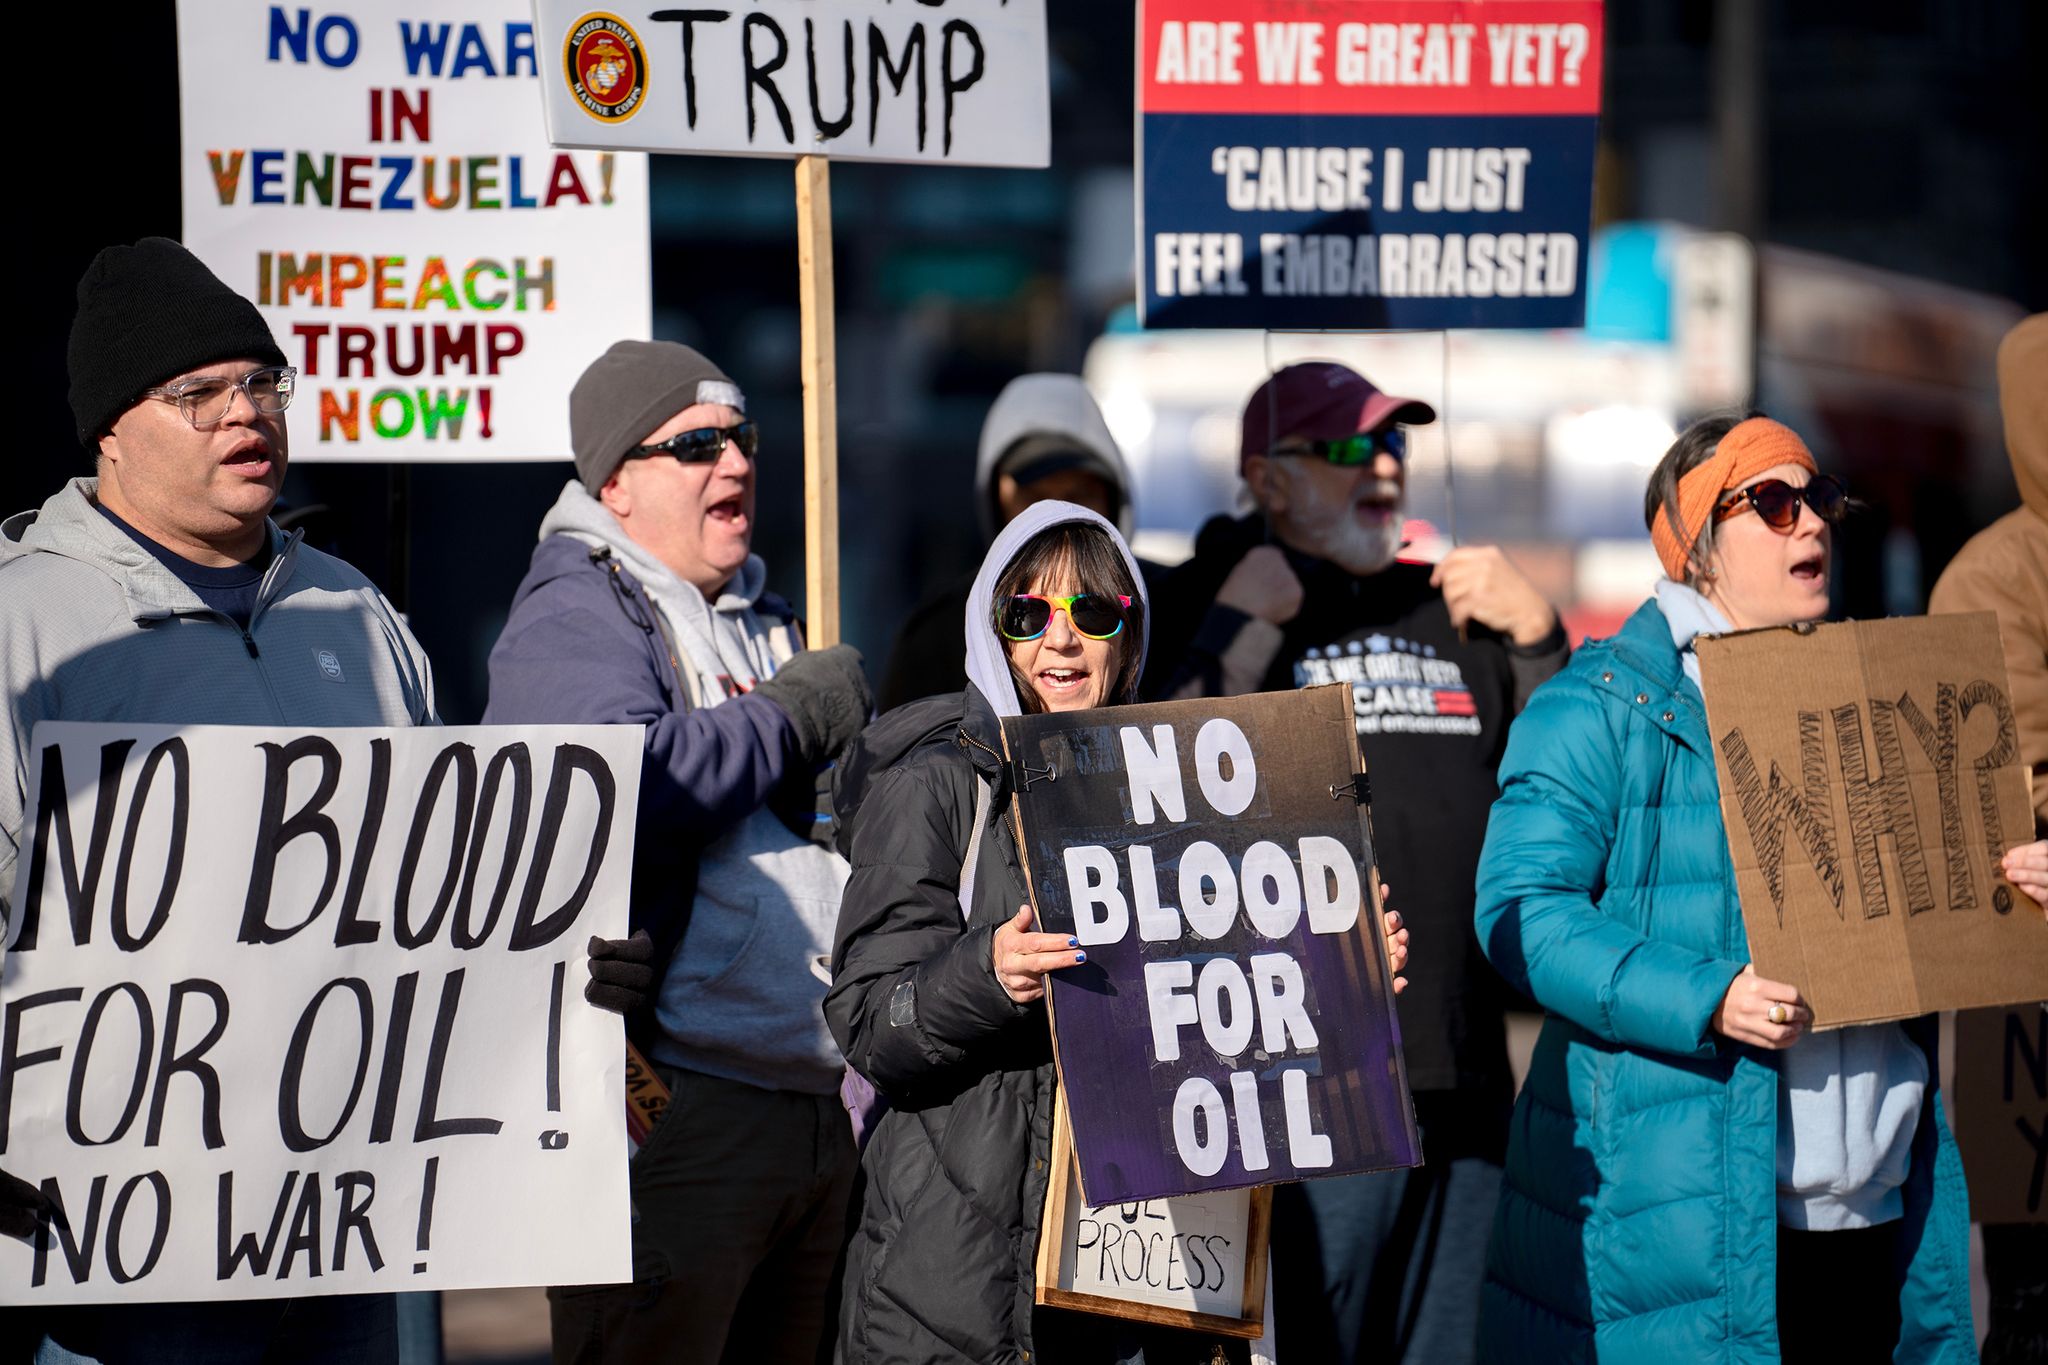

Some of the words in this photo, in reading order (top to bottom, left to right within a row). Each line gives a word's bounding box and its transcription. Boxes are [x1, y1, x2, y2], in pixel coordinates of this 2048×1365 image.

[267, 6, 360, 68] NO
[398, 20, 538, 79] WAR
[571, 19, 604, 46] UNITED
[605, 20, 636, 48] STATES
[1155, 21, 1243, 84] ARE
[1253, 22, 1324, 85] WE
[1335, 22, 1475, 86] GREAT
[1487, 23, 1589, 86] YET?
[368, 87, 431, 143] IN
[573, 81, 609, 116] MARINE
[614, 85, 642, 115] CORPS
[648, 9, 986, 157] TRUMP
[207, 151, 616, 210] VENEZUELA!
[1382, 148, 1404, 212] I
[1412, 147, 1531, 212] JUST
[256, 250, 556, 311] IMPEACH
[1155, 232, 1248, 296] FEEL
[1259, 232, 1578, 298] EMBARRASSED
[293, 322, 526, 379] TRUMP
[319, 388, 496, 442] NOW!
[1119, 718, 1257, 825] NO
[1720, 680, 2018, 930] WHY?
[7, 736, 190, 952] NO
[237, 735, 617, 951] BLOOD
[1063, 836, 1361, 946] BLOOD
[1144, 952, 1319, 1062] FOR
[0, 978, 230, 1155] FOR
[1172, 1068, 1334, 1177] OIL
[31, 1170, 172, 1288] NO
[1074, 1219, 1231, 1294] PROCESS
